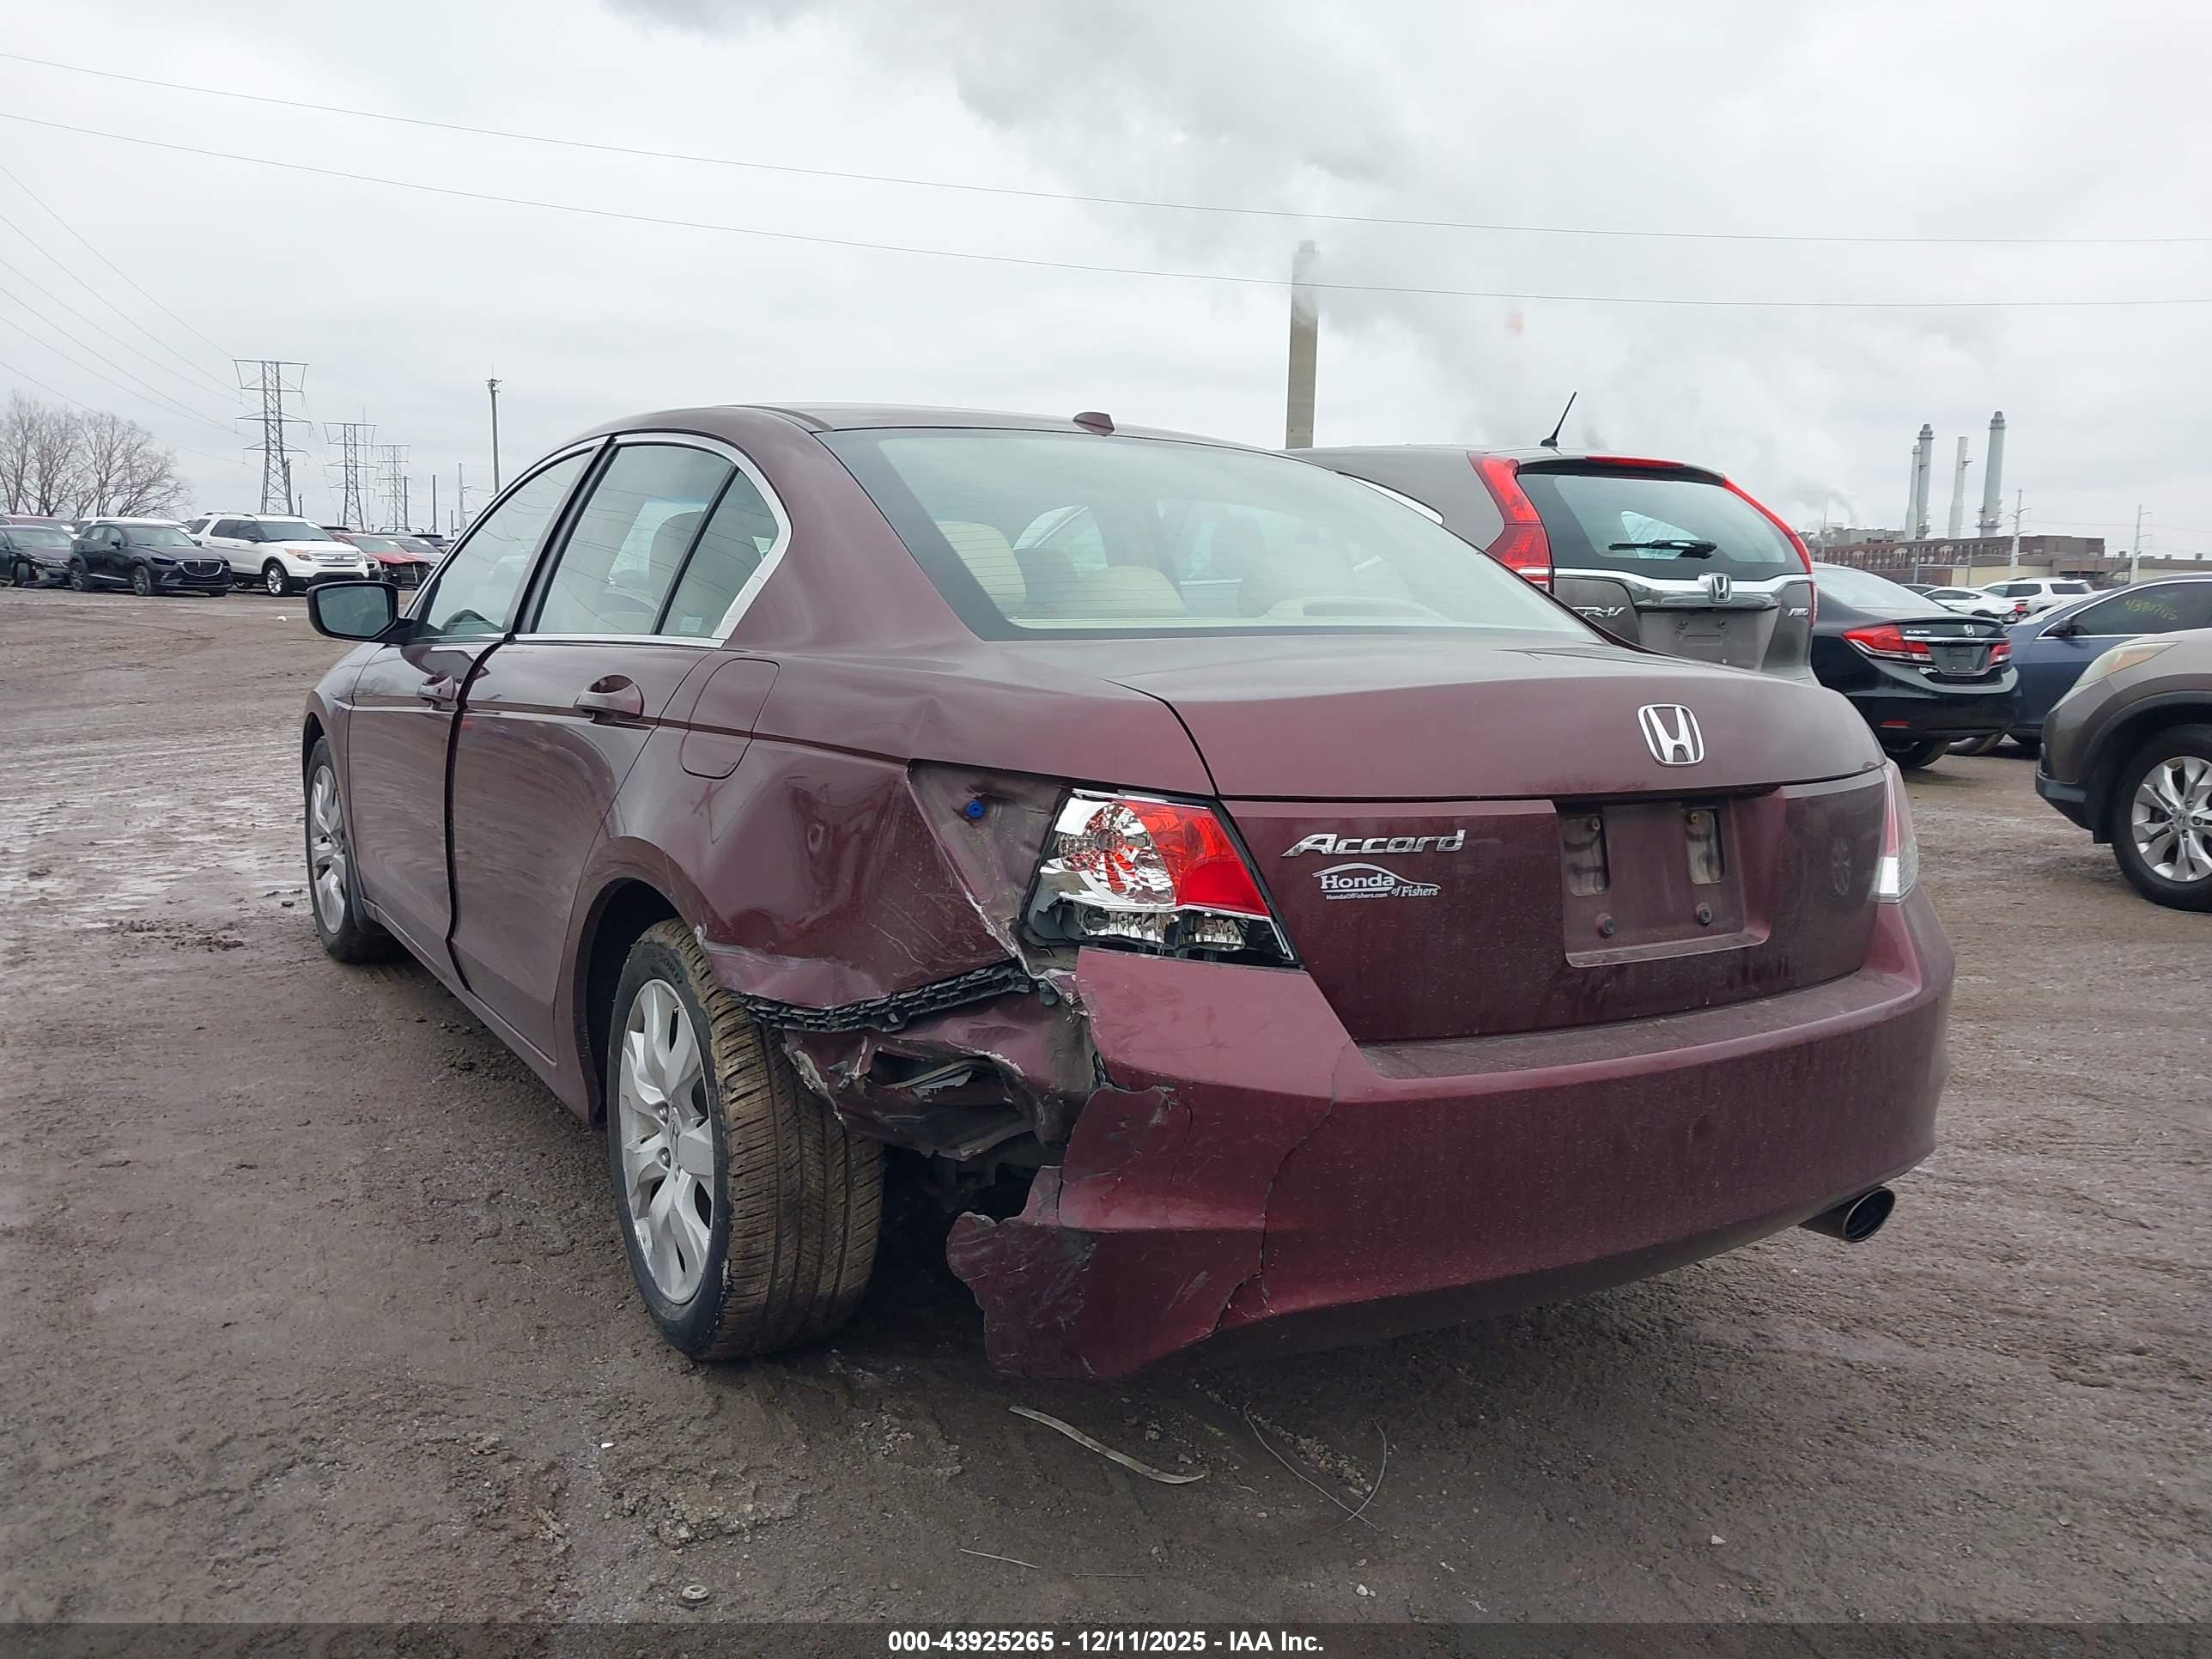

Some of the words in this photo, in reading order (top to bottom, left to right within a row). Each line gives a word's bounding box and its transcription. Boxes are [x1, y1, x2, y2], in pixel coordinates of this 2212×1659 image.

[1280, 830, 1467, 857] Accord
[1320, 873, 1395, 890] Honda
[1391, 885, 1401, 896] of
[1401, 886, 1438, 896] Fishers
